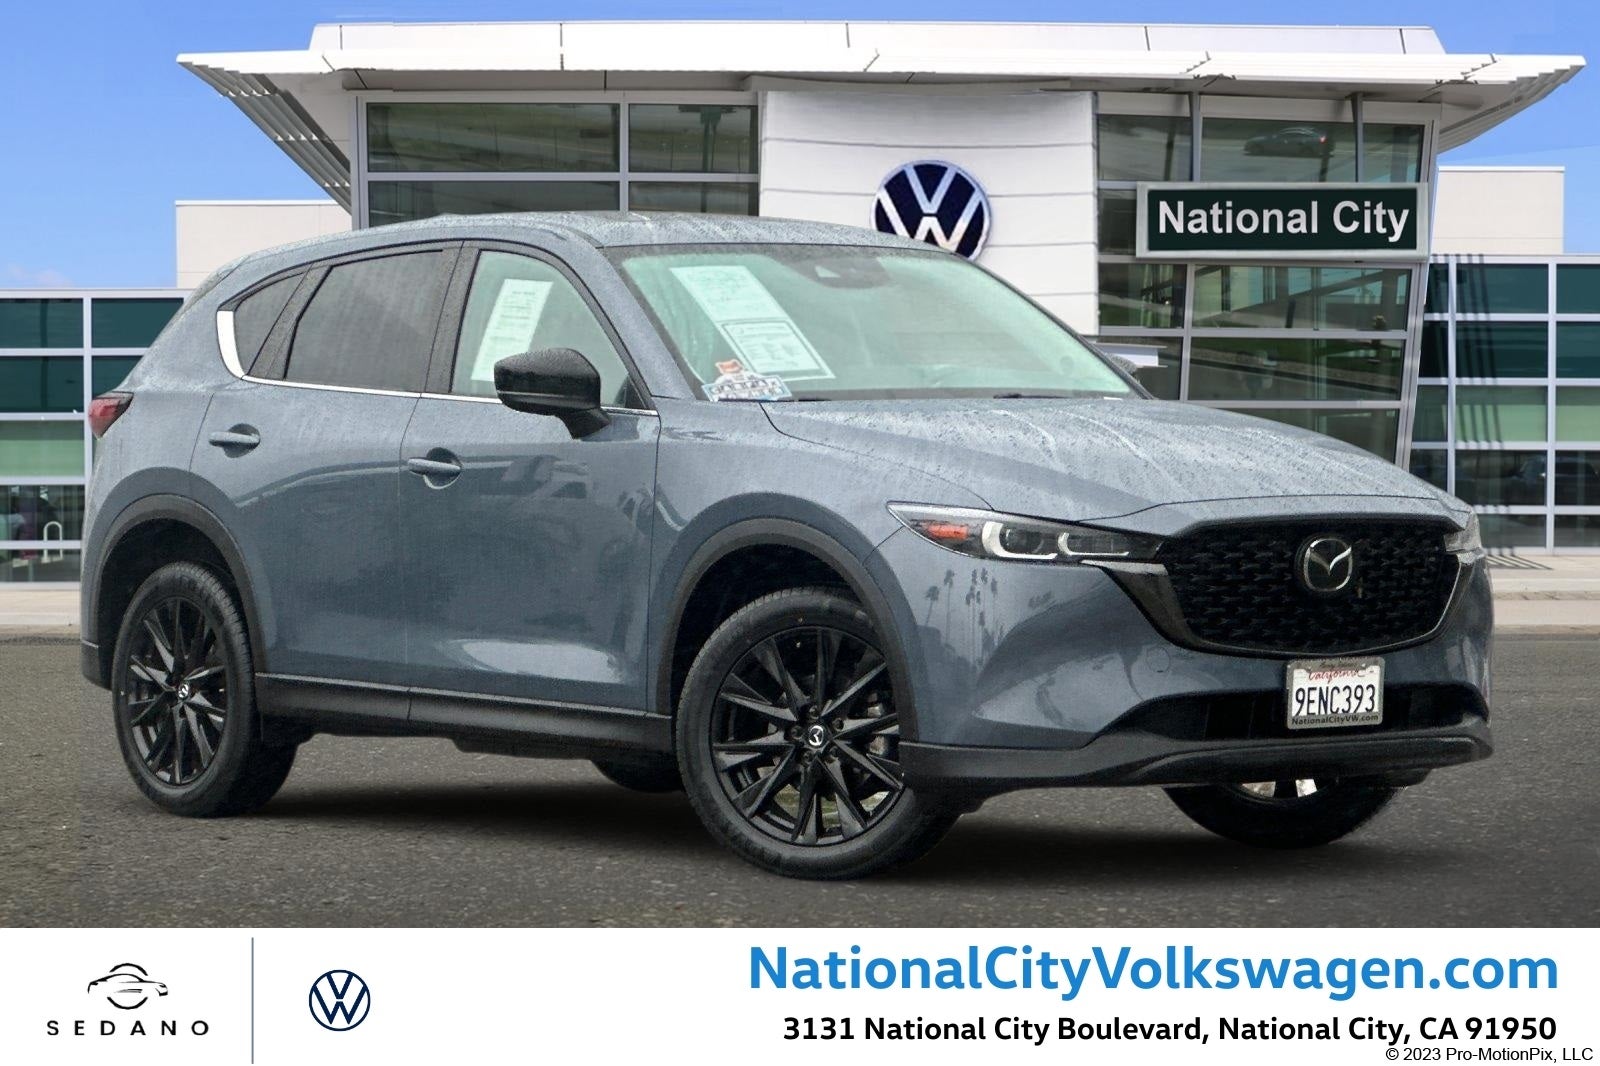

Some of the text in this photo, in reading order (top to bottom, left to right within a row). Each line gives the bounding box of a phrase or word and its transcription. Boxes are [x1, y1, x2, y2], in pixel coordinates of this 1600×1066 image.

[1158, 200, 1410, 243] National City
[1294, 684, 1376, 717] 9ENC393
[1291, 713, 1379, 725] NationalCityVW.com
